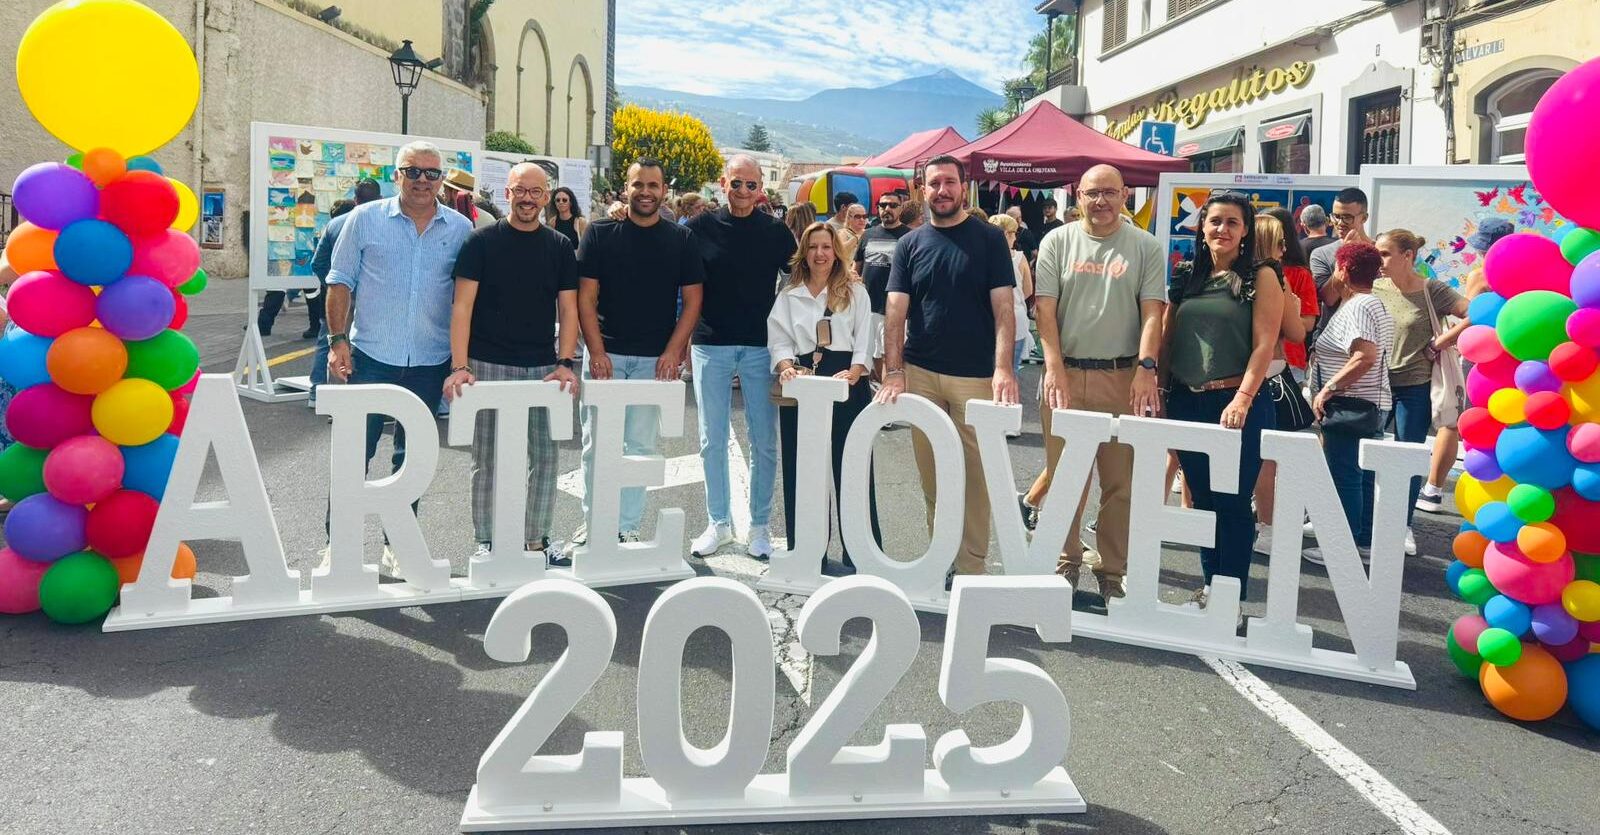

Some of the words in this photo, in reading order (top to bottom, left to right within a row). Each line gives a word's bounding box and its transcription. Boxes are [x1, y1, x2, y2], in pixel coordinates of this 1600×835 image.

[1149, 60, 1315, 129] Regalitos
[1460, 40, 1504, 61] LVARIO
[119, 373, 687, 616] ARTE
[768, 375, 1432, 673] JOVEN
[477, 575, 1072, 808] 2025
